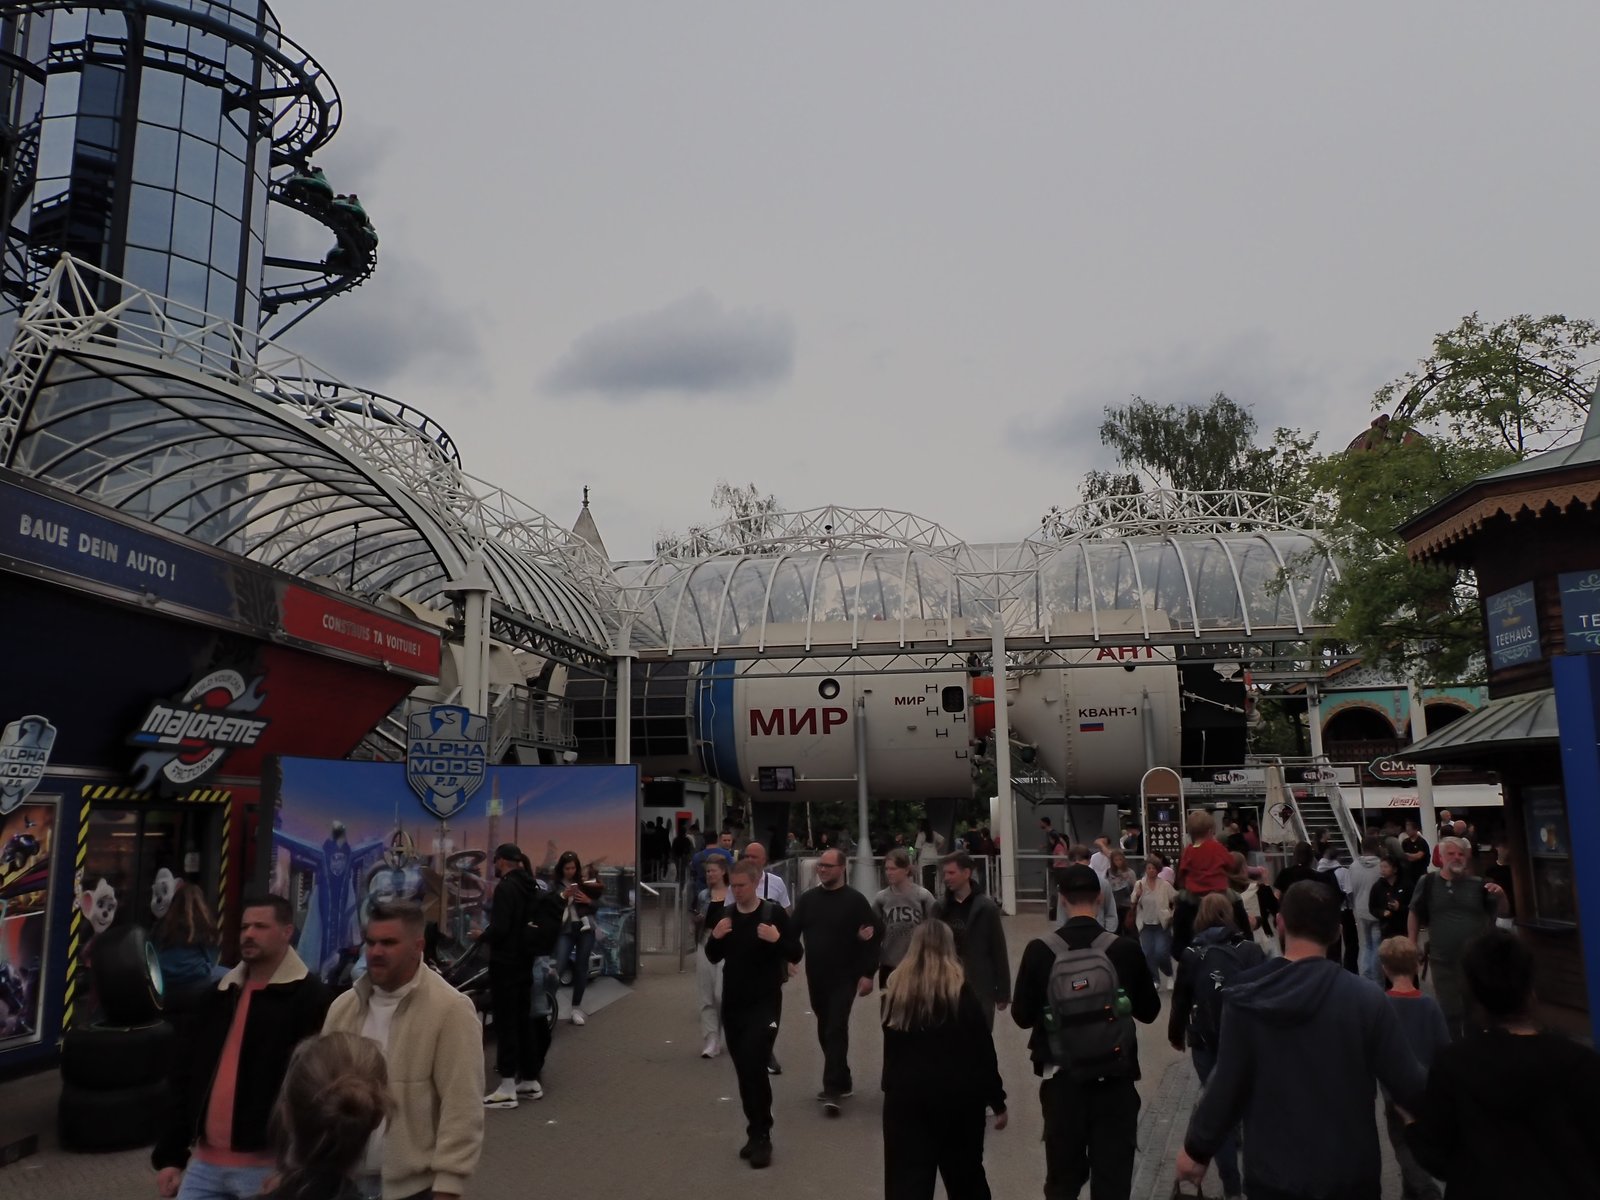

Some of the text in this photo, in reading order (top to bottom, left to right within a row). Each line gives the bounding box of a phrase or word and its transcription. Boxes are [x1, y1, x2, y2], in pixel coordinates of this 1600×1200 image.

[20, 514, 70, 547] BAUE
[78, 533, 119, 563] DEIN
[373, 630, 384, 645] TA
[1495, 625, 1533, 646] TEEHAUS
[894, 696, 926, 706] МИР
[750, 707, 848, 736] МИР
[410, 742, 485, 756] ALPHA
[411, 759, 482, 774] MODS
[434, 777, 459, 786] P.D.
